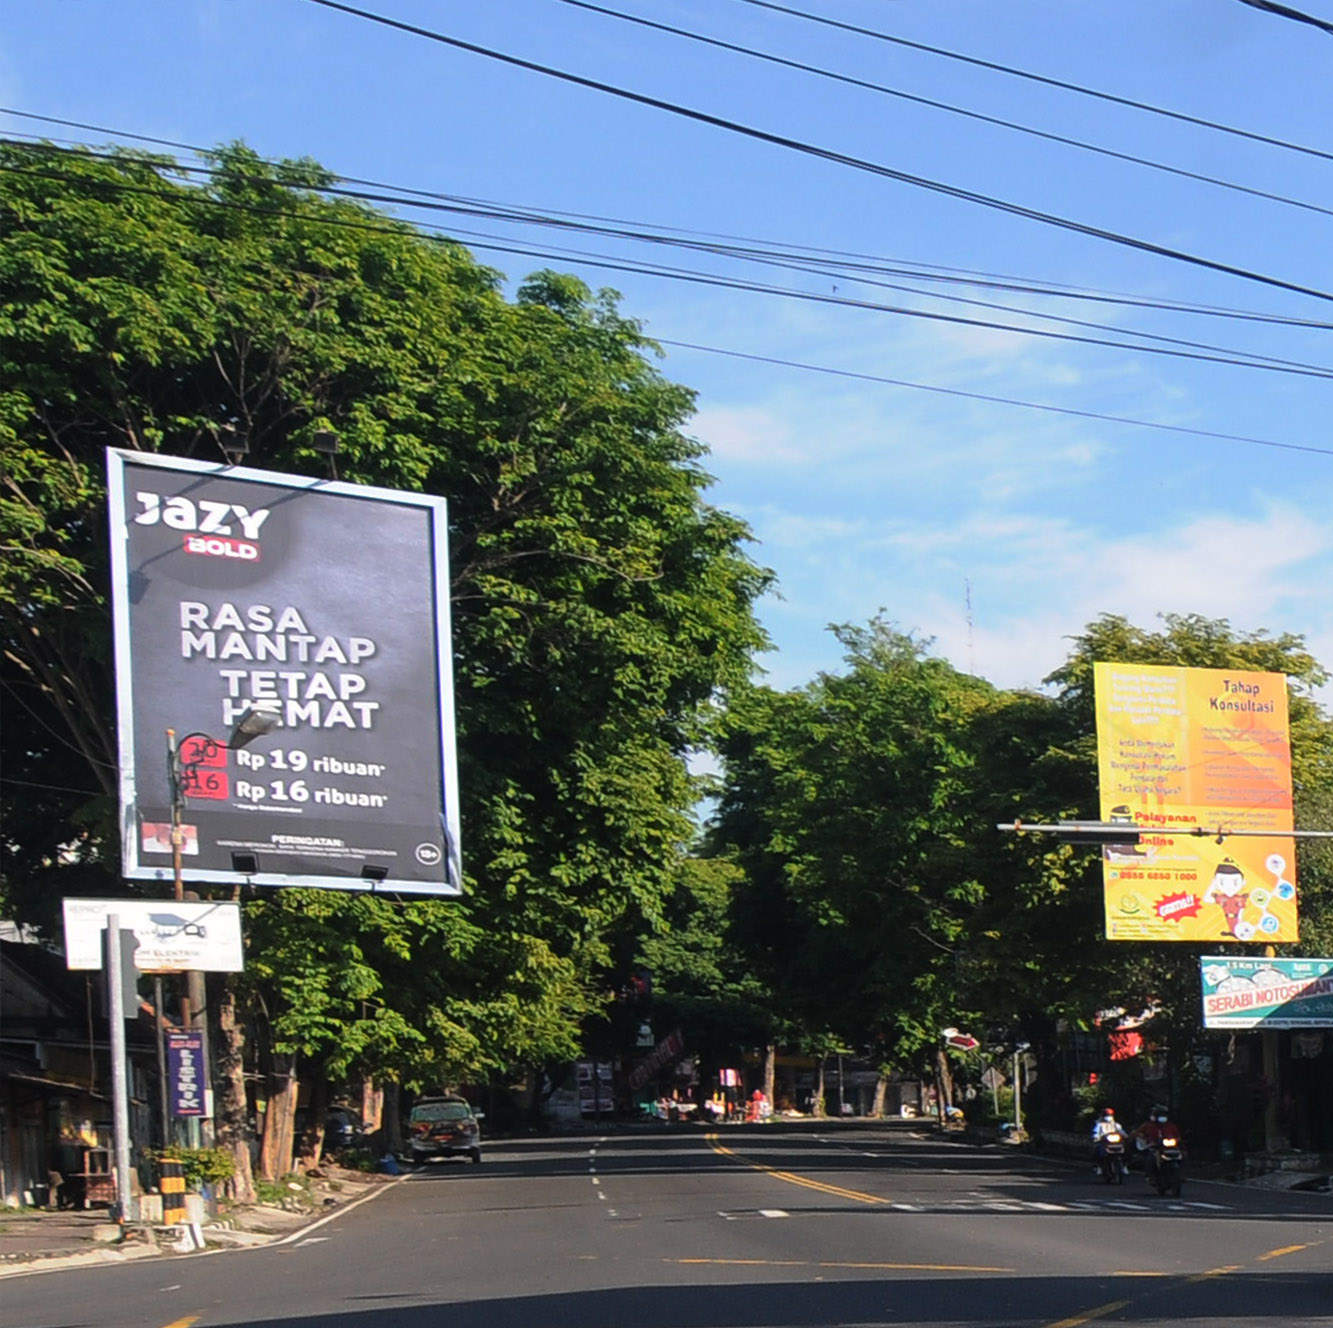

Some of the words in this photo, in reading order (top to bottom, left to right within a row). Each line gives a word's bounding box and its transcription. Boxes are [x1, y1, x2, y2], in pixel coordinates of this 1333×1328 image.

[187, 537, 258, 560] BOLD
[179, 601, 309, 634] RASA
[181, 630, 376, 664] MANTAP
[219, 669, 366, 700] TETAP
[1223, 680, 1260, 697] Tahap
[222, 697, 380, 729] HEMAT
[1209, 697, 1275, 713] Konsultasi
[236, 750, 265, 771] Rp
[269, 750, 308, 772] 19
[236, 781, 265, 802] Rp
[270, 781, 309, 801] 16
[1135, 811, 1197, 824] Pelayanan
[418, 848, 438, 860] 18+
[1207, 996, 1253, 1013] SERABI
